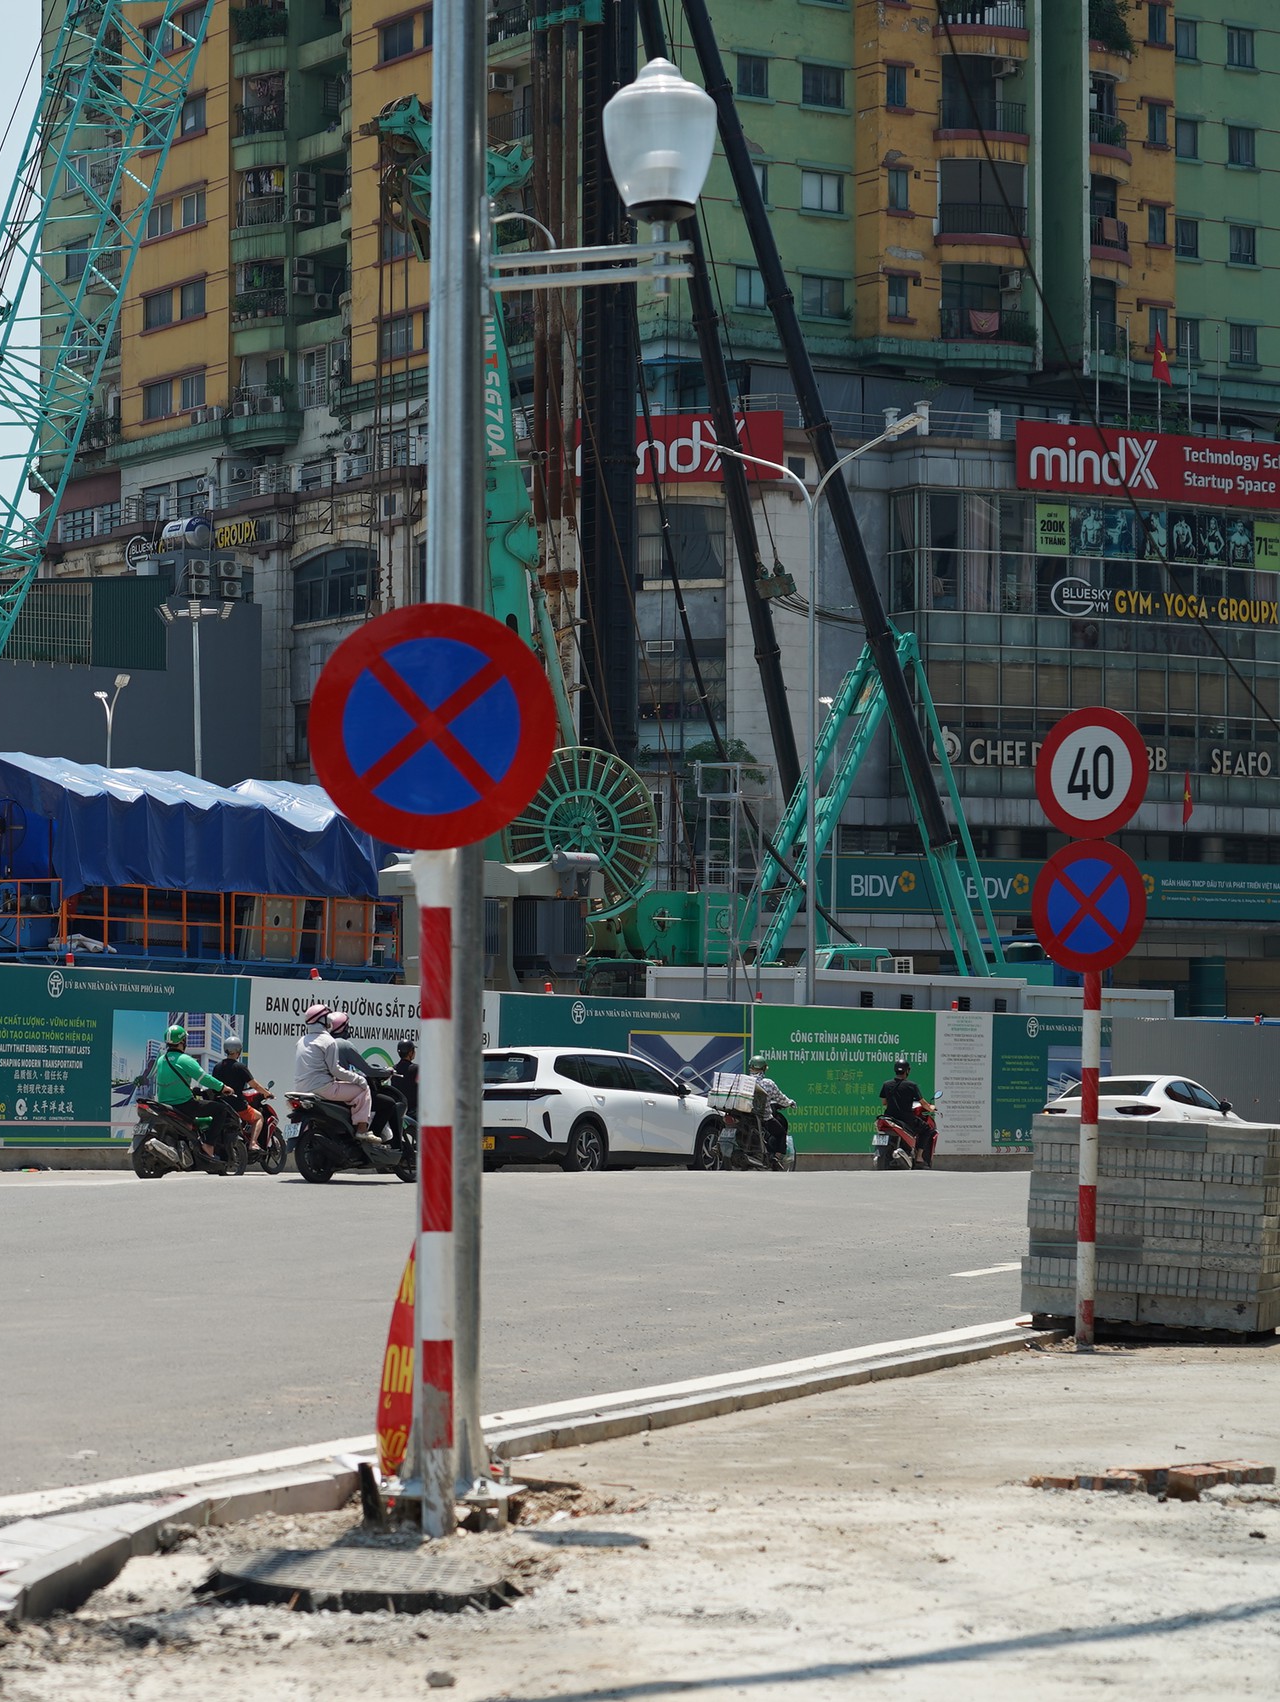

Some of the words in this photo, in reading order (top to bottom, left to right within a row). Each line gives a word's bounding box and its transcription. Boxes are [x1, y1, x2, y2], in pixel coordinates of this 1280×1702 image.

[1030, 436, 1159, 491] mindX
[1183, 446, 1259, 472] Technology
[1184, 471, 1234, 494] Startup
[1236, 475, 1276, 495] Space
[217, 520, 258, 549] GROUPX
[1040, 520, 1066, 533] 200K
[1045, 536, 1066, 546] THÁNG
[1255, 536, 1268, 556] 71
[1062, 587, 1112, 600] BLUESKY
[1114, 590, 1152, 615] GYM
[1163, 591, 1208, 620] YOGA
[1218, 597, 1279, 625] GROUPX
[970, 738, 1026, 766] CHEF
[1211, 749, 1271, 777] SEAFO
[1067, 745, 1114, 800] 40
[850, 874, 899, 897] BIDV
[966, 877, 1013, 899] BDV
[74, 981, 86, 990] BAN
[87, 981, 105, 991] NHÂN
[105, 981, 118, 991] DÂN
[164, 985, 175, 995] NỘI
[266, 996, 289, 1012] BAN
[342, 997, 382, 1017] ĐƯỜNG
[386, 997, 405, 1018] SẮT
[86, 1019, 97, 1028] TIN
[255, 1022, 281, 1036] HANOI
[350, 1026, 381, 1040] RALWAY
[10, 1030, 23, 1041] TẠO
[24, 1031, 40, 1040] GIAO
[42, 1030, 64, 1040] THÔNG
[82, 1033, 94, 1043] ĐẠI
[790, 1030, 813, 1043] CÔNG
[814, 1030, 838, 1044] TRÌNH
[840, 1033, 862, 1044] ĐANG
[863, 1033, 877, 1044] THI
[878, 1031, 900, 1045] CÔNG
[13, 1044, 25, 1053] THAT
[49, 1045, 65, 1054] TRUST
[65, 1045, 76, 1054] THAT
[76, 1046, 91, 1055] LASTS
[759, 1047, 787, 1061] THÀNH
[789, 1048, 809, 1064] THẬT
[811, 1051, 825, 1062] XIN
[826, 1047, 839, 1062] LỖI
[840, 1049, 848, 1062] VÌ
[849, 1050, 865, 1062] LƯU
[866, 1050, 894, 1062] THÔNG
[894, 1049, 910, 1062] BẤT
[910, 1050, 928, 1065] TIỆN
[0, 1058, 20, 1068] SHAPING
[21, 1059, 41, 1068] MODERN
[42, 1059, 83, 1069] TRANSPORTATION
[787, 1106, 849, 1116] CONSTRUCTION
[850, 1106, 859, 1115] IN
[810, 1122, 826, 1132] FOR
[827, 1122, 842, 1132] THE
